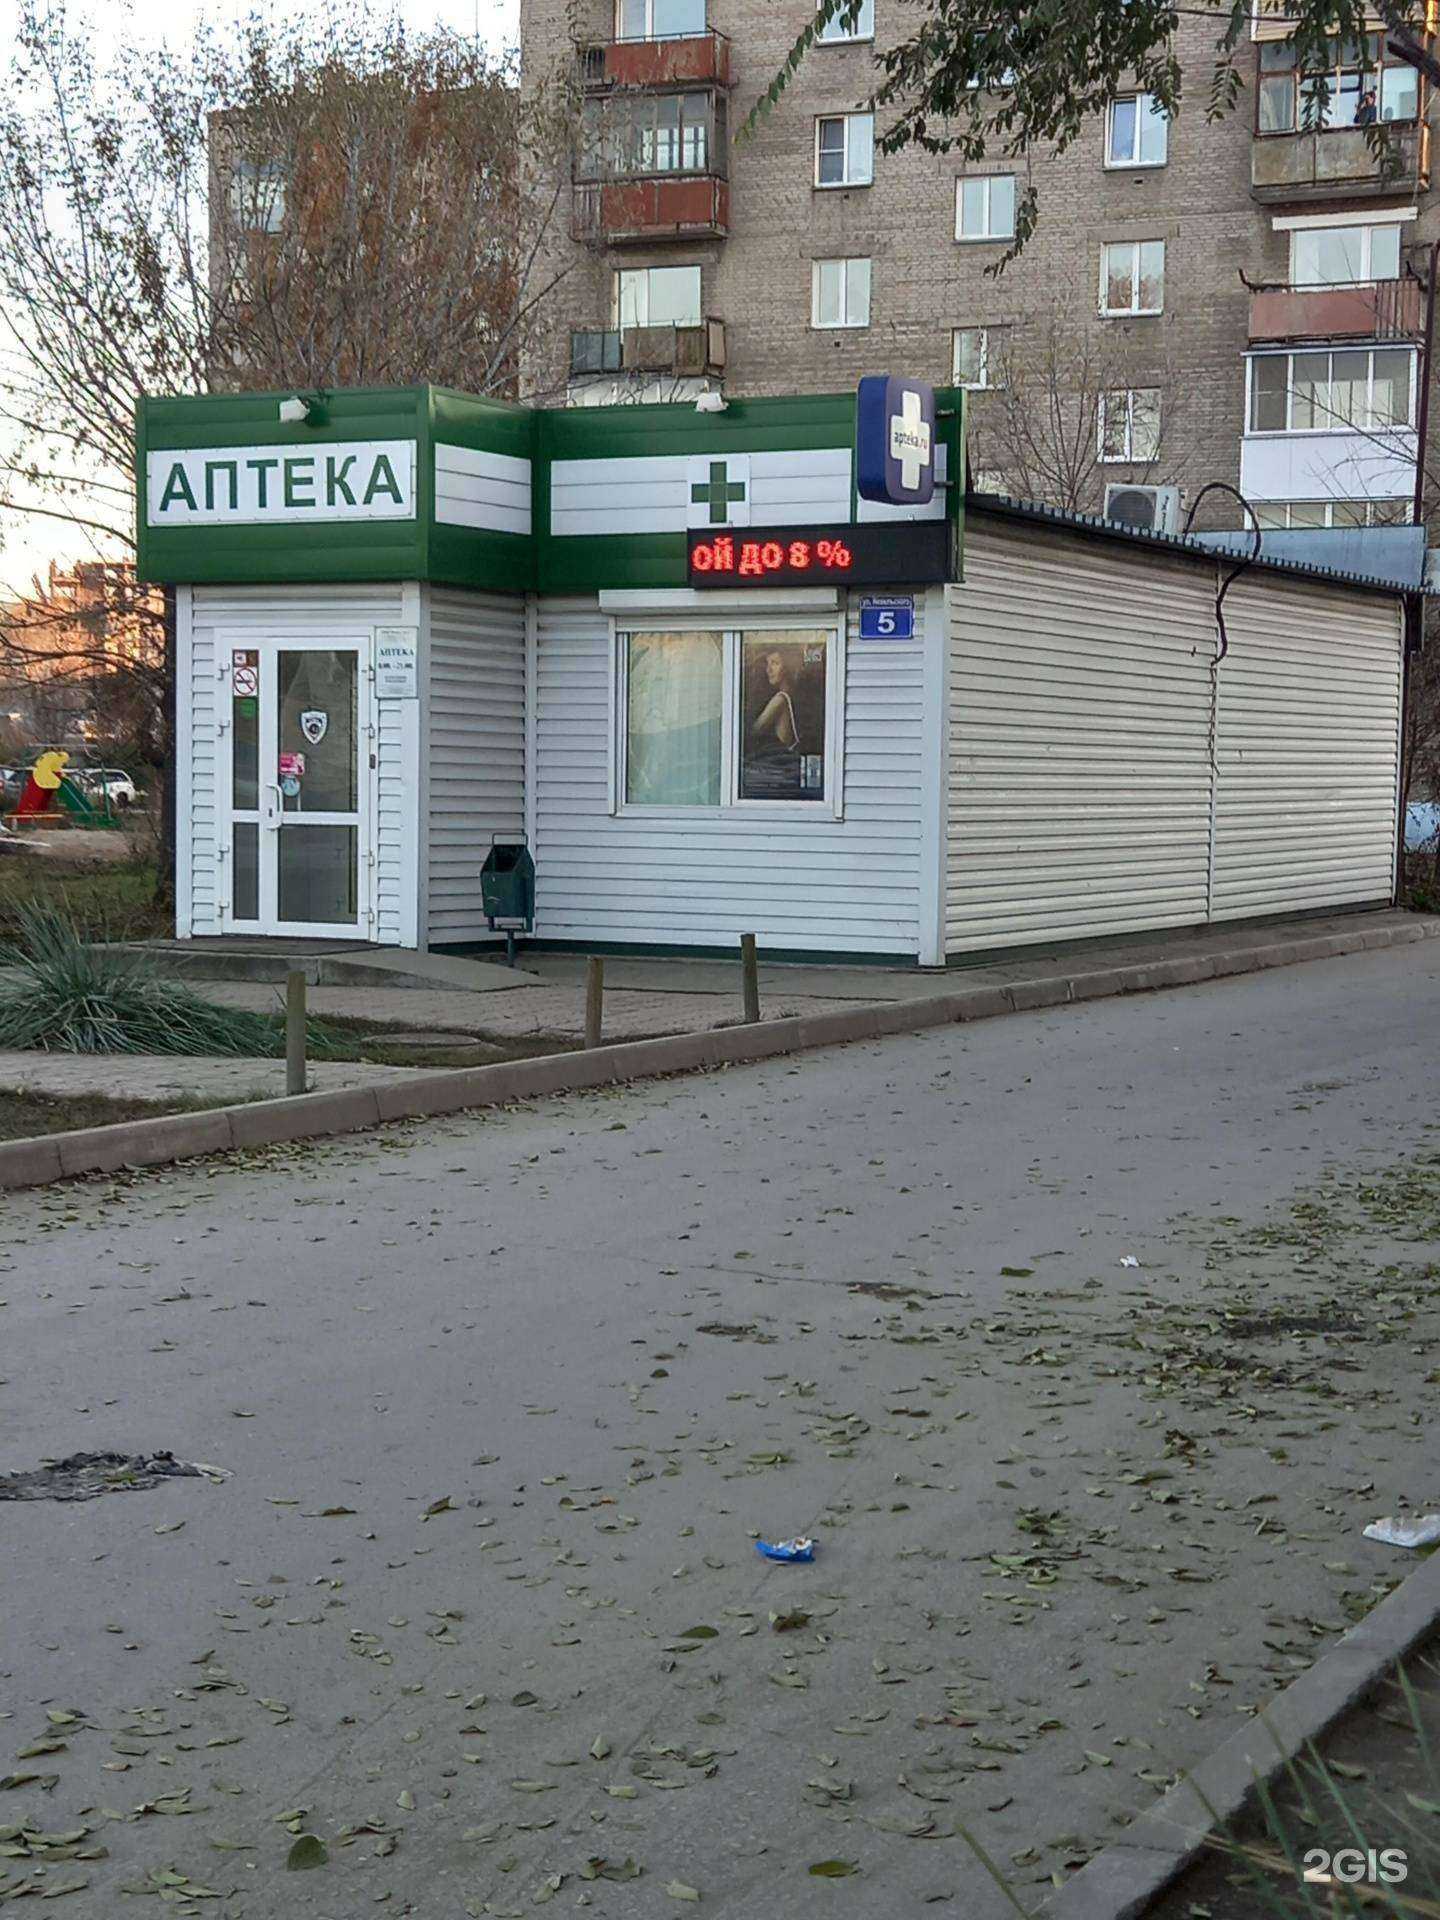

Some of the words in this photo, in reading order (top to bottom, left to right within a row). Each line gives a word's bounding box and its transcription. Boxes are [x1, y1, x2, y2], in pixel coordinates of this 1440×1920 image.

[894, 431, 928, 450] apteka.ru
[159, 454, 403, 512] АПТЕКА
[789, 541, 810, 568] 8
[817, 540, 851, 568] %
[877, 611, 896, 634] 5
